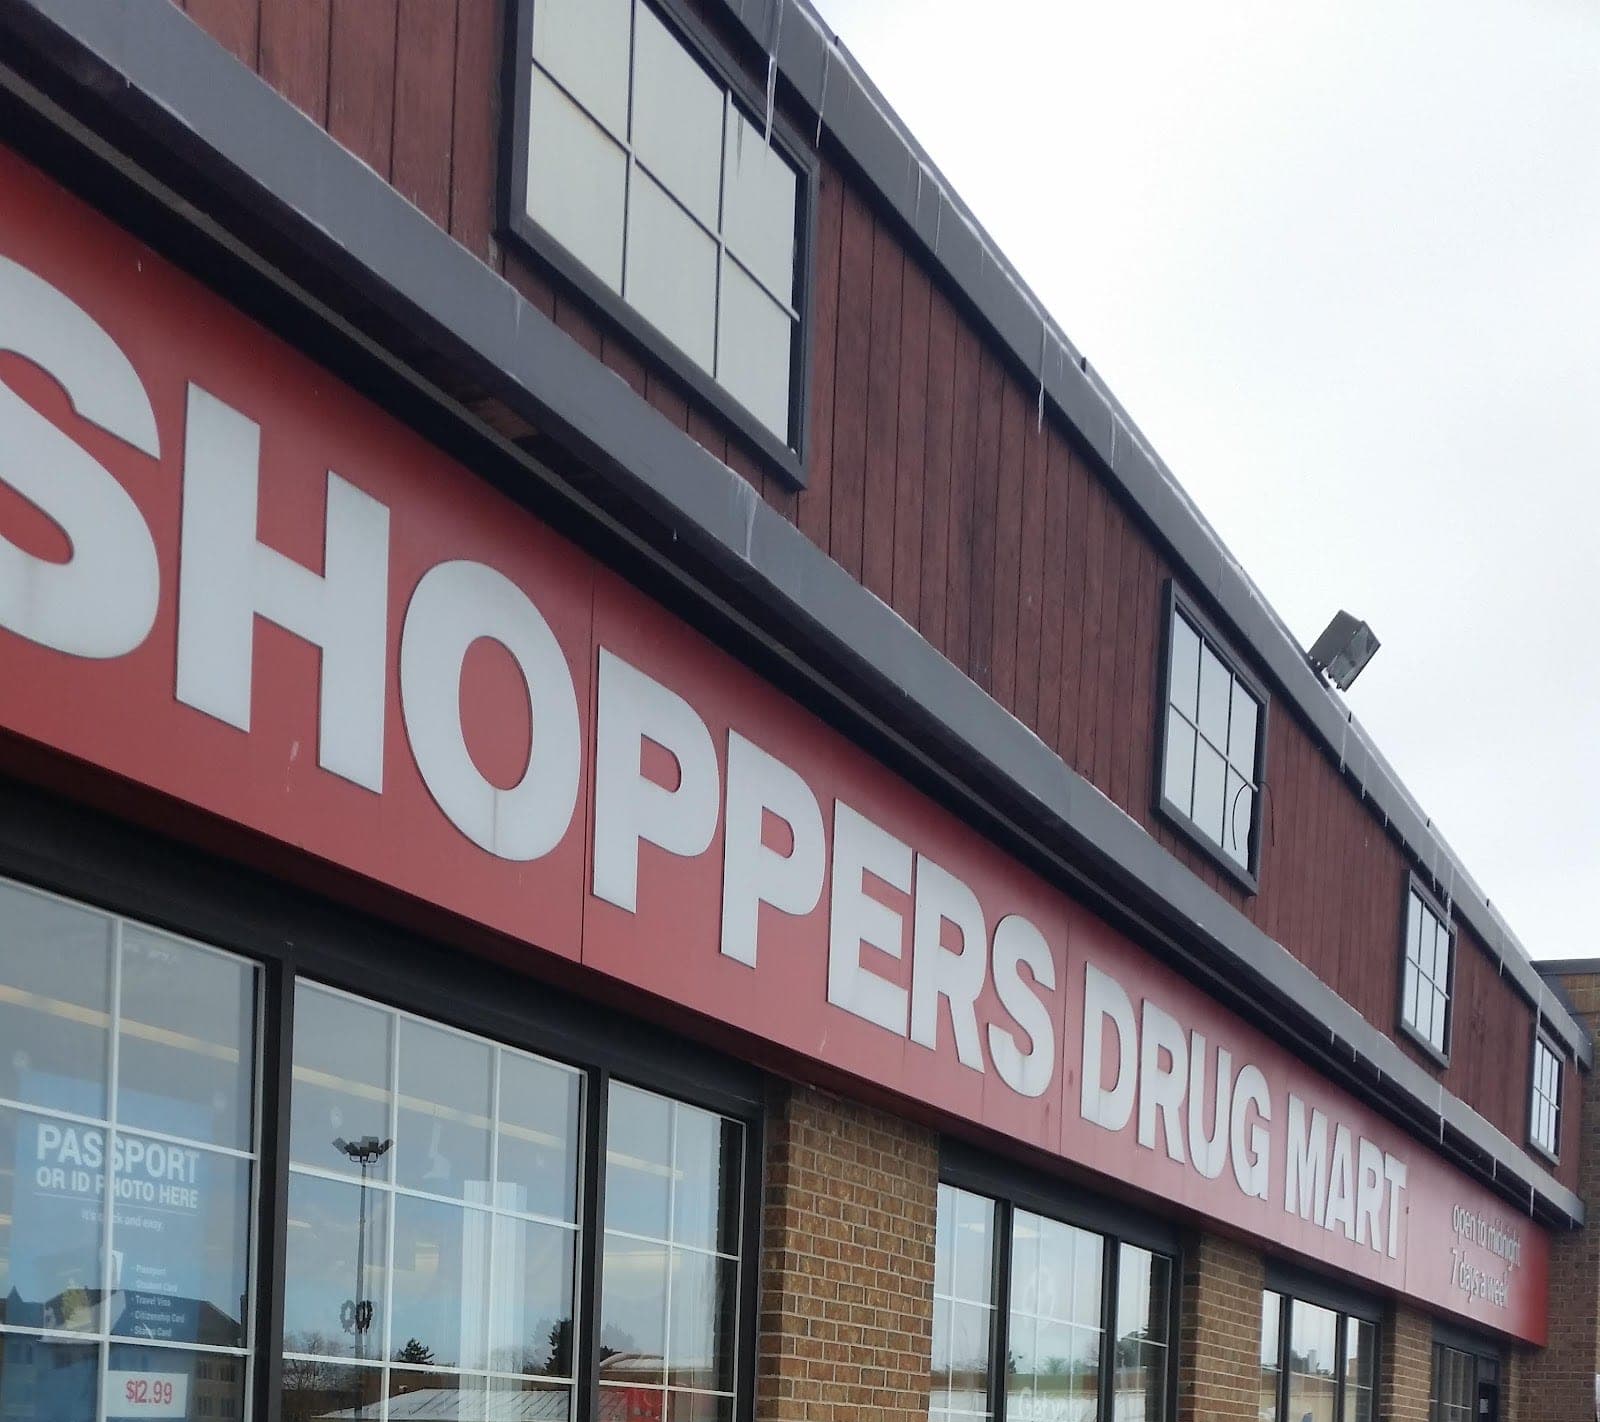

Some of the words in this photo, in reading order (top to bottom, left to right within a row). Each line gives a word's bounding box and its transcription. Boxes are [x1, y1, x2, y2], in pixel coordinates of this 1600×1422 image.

[0, 252, 1056, 1098] SHOPPERS
[1080, 960, 1272, 1202] DRUG
[1284, 1091, 1408, 1260] MART
[36, 1123, 200, 1184] PASSPORT
[36, 1166, 66, 1190] OR
[71, 1170, 91, 1193] ID
[158, 1183, 199, 1210] HERE
[1450, 1247, 1458, 1289] 7
[125, 1379, 173, 1406] $12.99
